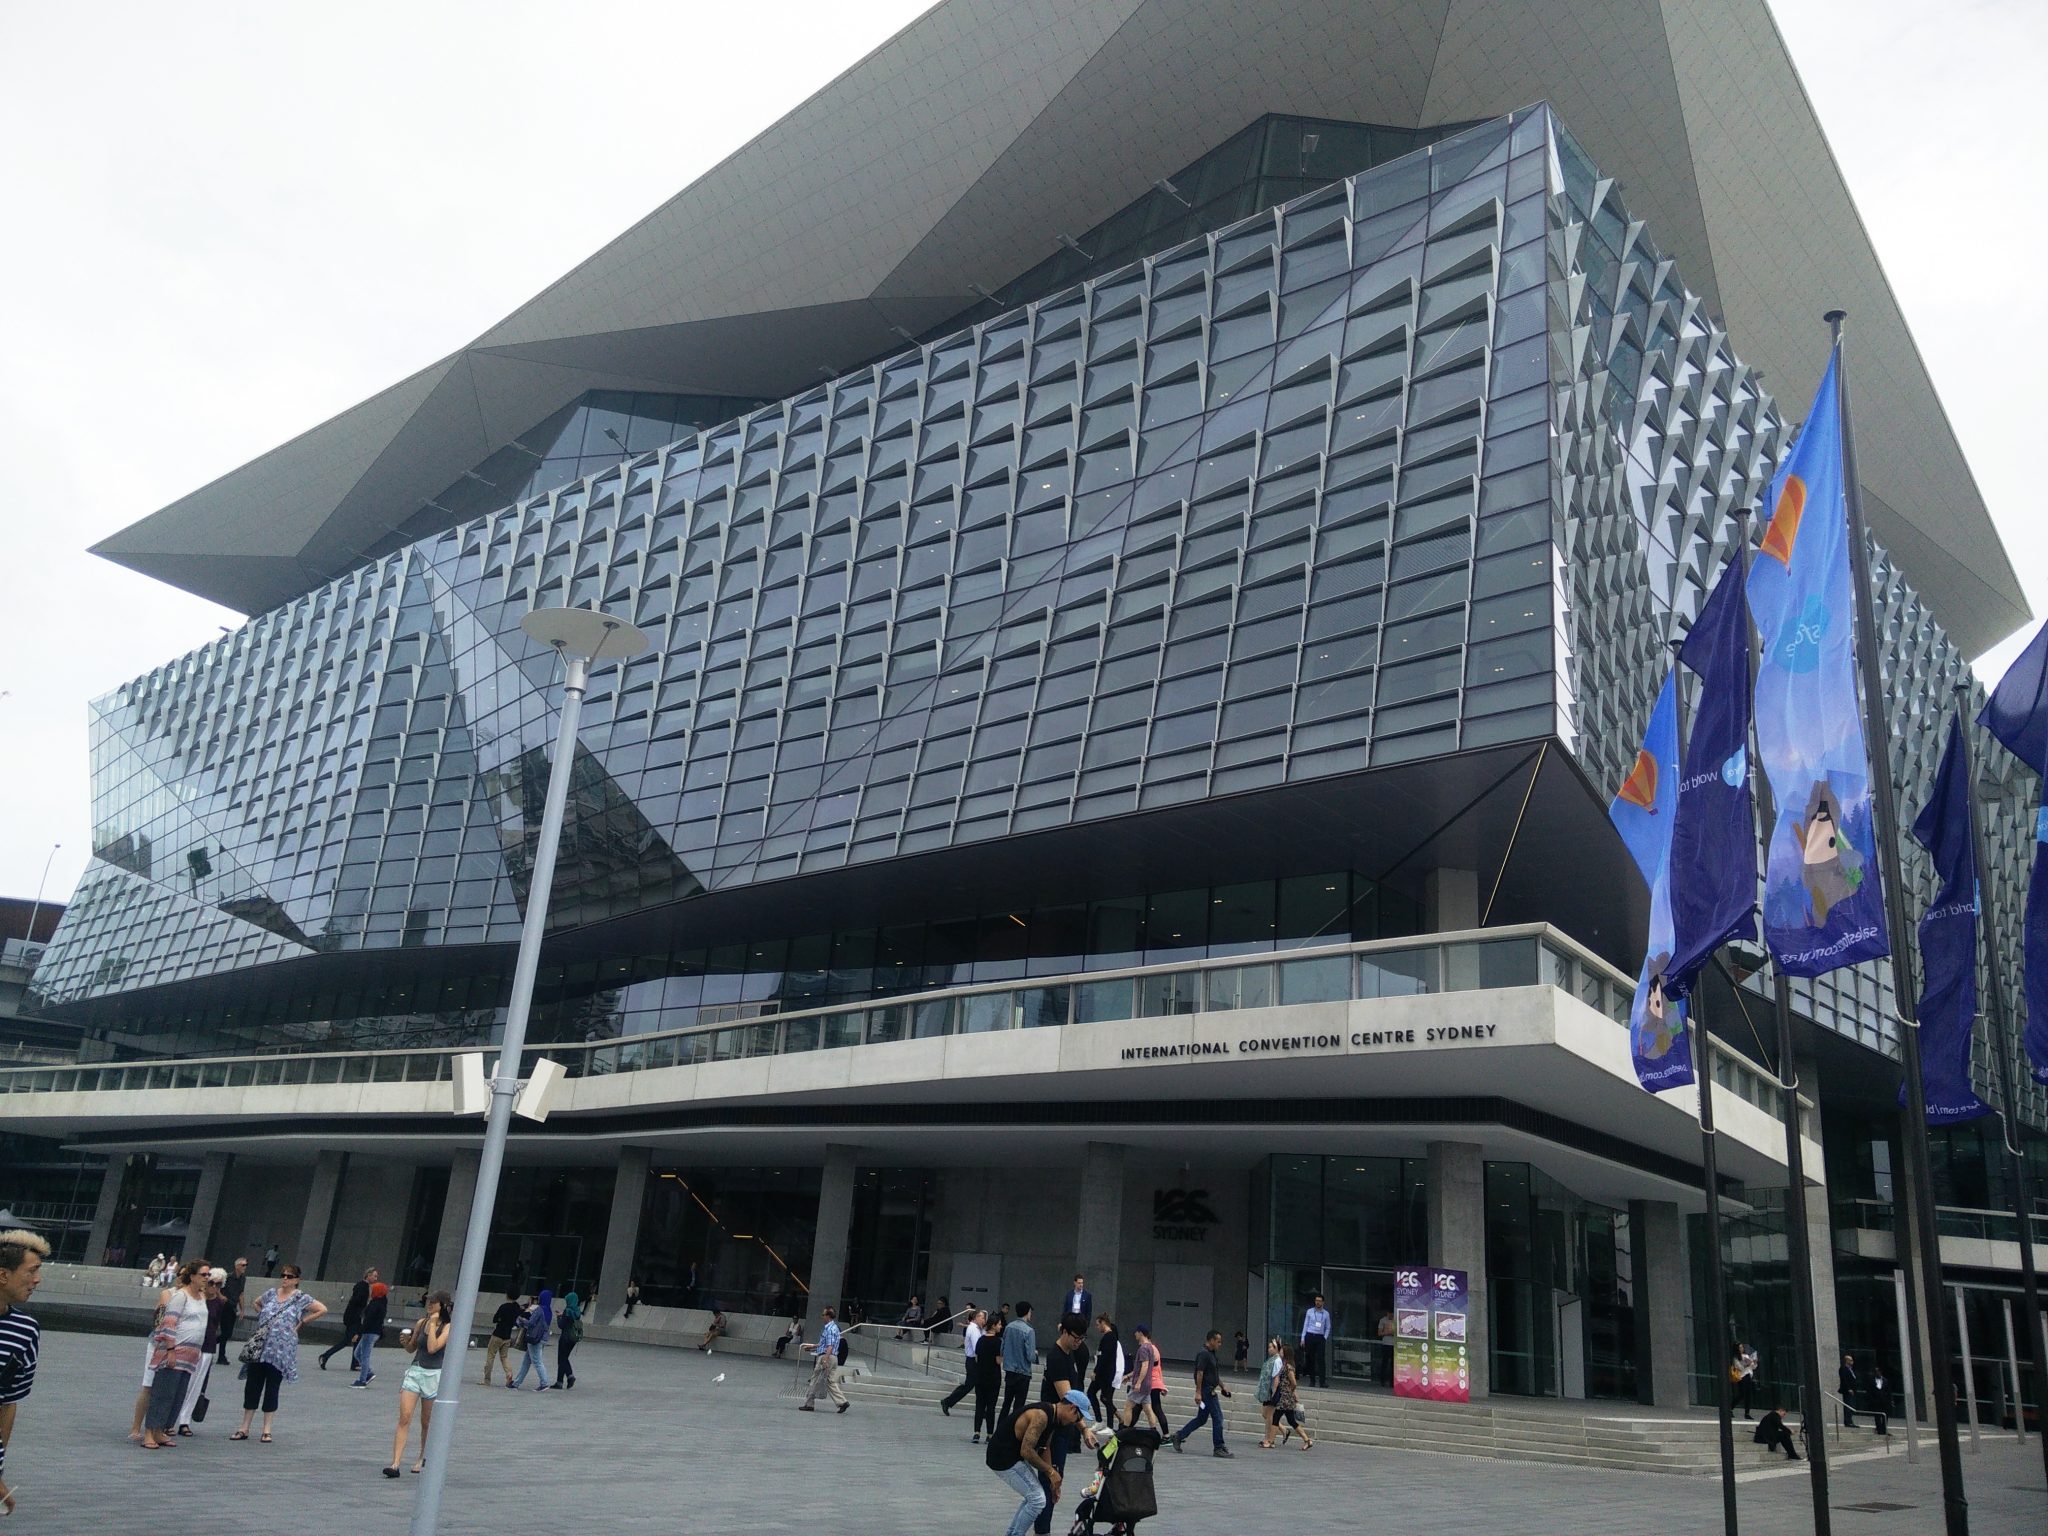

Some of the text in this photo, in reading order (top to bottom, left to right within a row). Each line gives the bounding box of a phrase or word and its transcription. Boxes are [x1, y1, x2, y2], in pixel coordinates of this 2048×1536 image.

[1121, 1024, 1497, 1060] INTERNATIONAL CONVENTION CENTRE SYDNEY
[1153, 1225, 1209, 1241] SYDNEY
[1396, 1288, 1419, 1296] SYDNEY
[1434, 1290, 1457, 1299] SYDNEY
